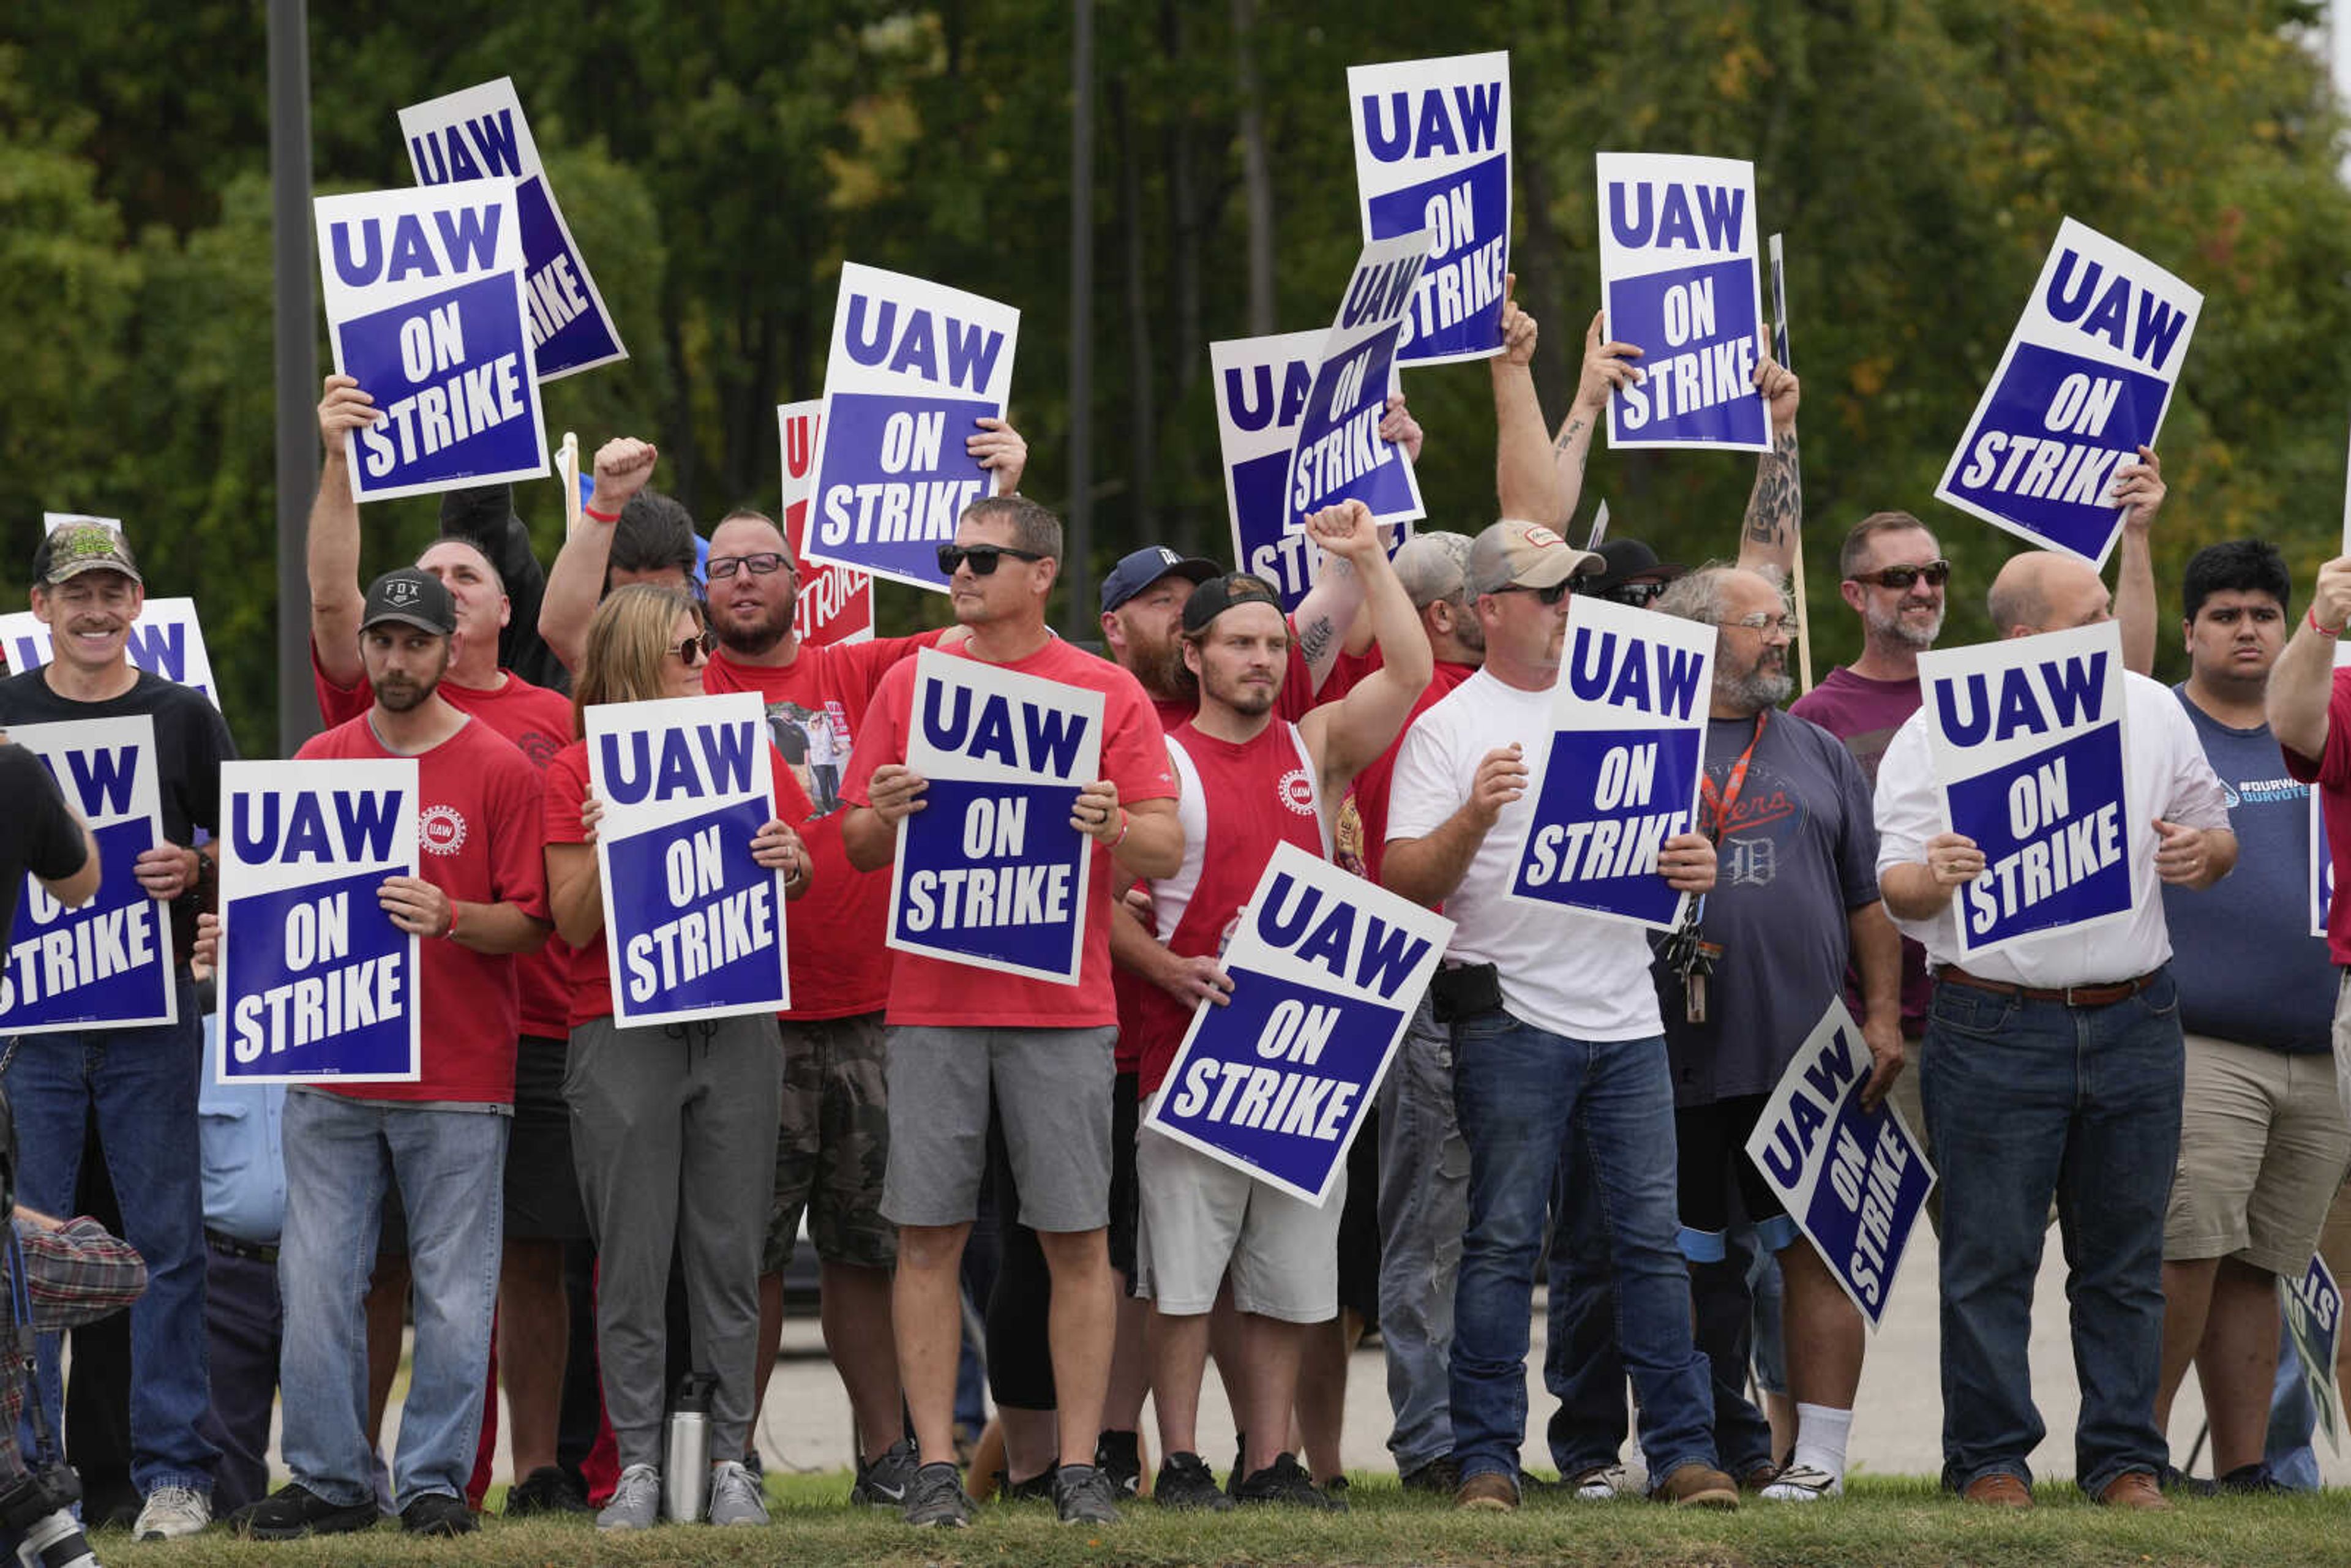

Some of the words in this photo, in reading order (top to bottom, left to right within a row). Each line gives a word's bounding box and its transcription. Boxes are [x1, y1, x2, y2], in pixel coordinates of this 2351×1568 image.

[412, 108, 522, 186] UAW
[1362, 81, 1501, 163] UAW
[331, 203, 502, 287] UAW
[1425, 181, 1474, 260] ON
[1609, 182, 1745, 252] UAW
[1342, 252, 1425, 330] UAW
[1663, 276, 1715, 347] ON
[2046, 247, 2187, 372] UAW
[400, 301, 465, 383] ON
[845, 293, 1004, 394] UAW
[1622, 336, 1757, 430] STRIKE
[362, 353, 524, 478] STRIKE
[1224, 359, 1311, 432] UA
[1329, 347, 1373, 423] ON
[2044, 373, 2122, 437] ON
[880, 411, 945, 474] ON
[1295, 400, 1393, 512] STRIKE
[386, 583, 419, 596] FOX
[1570, 627, 1704, 721] UAW
[1935, 651, 2107, 748] UAW
[600, 721, 754, 805] UAW
[923, 677, 1089, 779] UAW
[1291, 787, 1310, 797] UAW
[1595, 743, 1657, 811] ON
[2008, 756, 2069, 841] ON
[233, 790, 403, 865] UAW
[429, 822, 454, 838] UAW
[666, 824, 724, 908] ON
[963, 797, 1028, 859] ON
[1970, 801, 2121, 935] STRIKE
[285, 891, 349, 972] ON
[906, 863, 1071, 932] STRIKE
[1257, 871, 1432, 1000] UAW
[626, 880, 773, 1003] STRIKE
[234, 951, 402, 1064] STRIKE
[1256, 999, 1341, 1066] ON
[1173, 1058, 1360, 1142] STRIKE
[1763, 1025, 1854, 1190] UAW
[1830, 1123, 1867, 1213] ON
[1850, 1119, 1908, 1307] STRIKE
